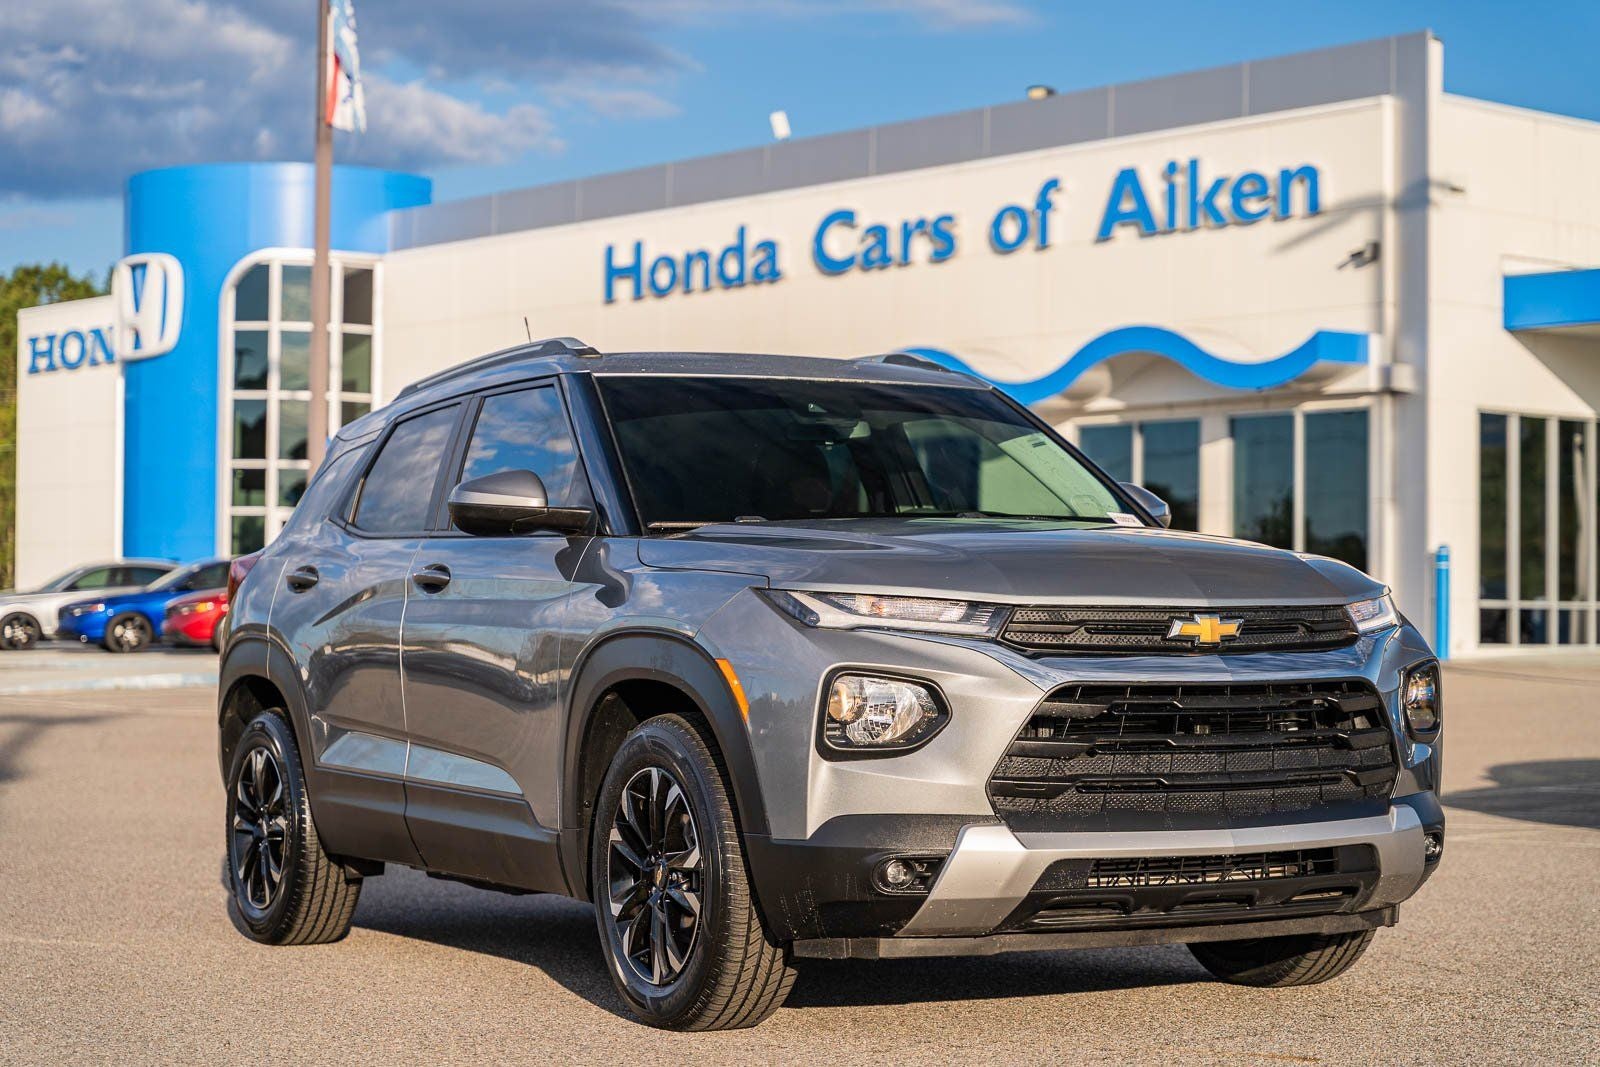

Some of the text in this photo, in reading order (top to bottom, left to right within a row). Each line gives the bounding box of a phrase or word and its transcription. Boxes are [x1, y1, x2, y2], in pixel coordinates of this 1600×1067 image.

[604, 158, 1321, 303] Honda Cars of Aiken
